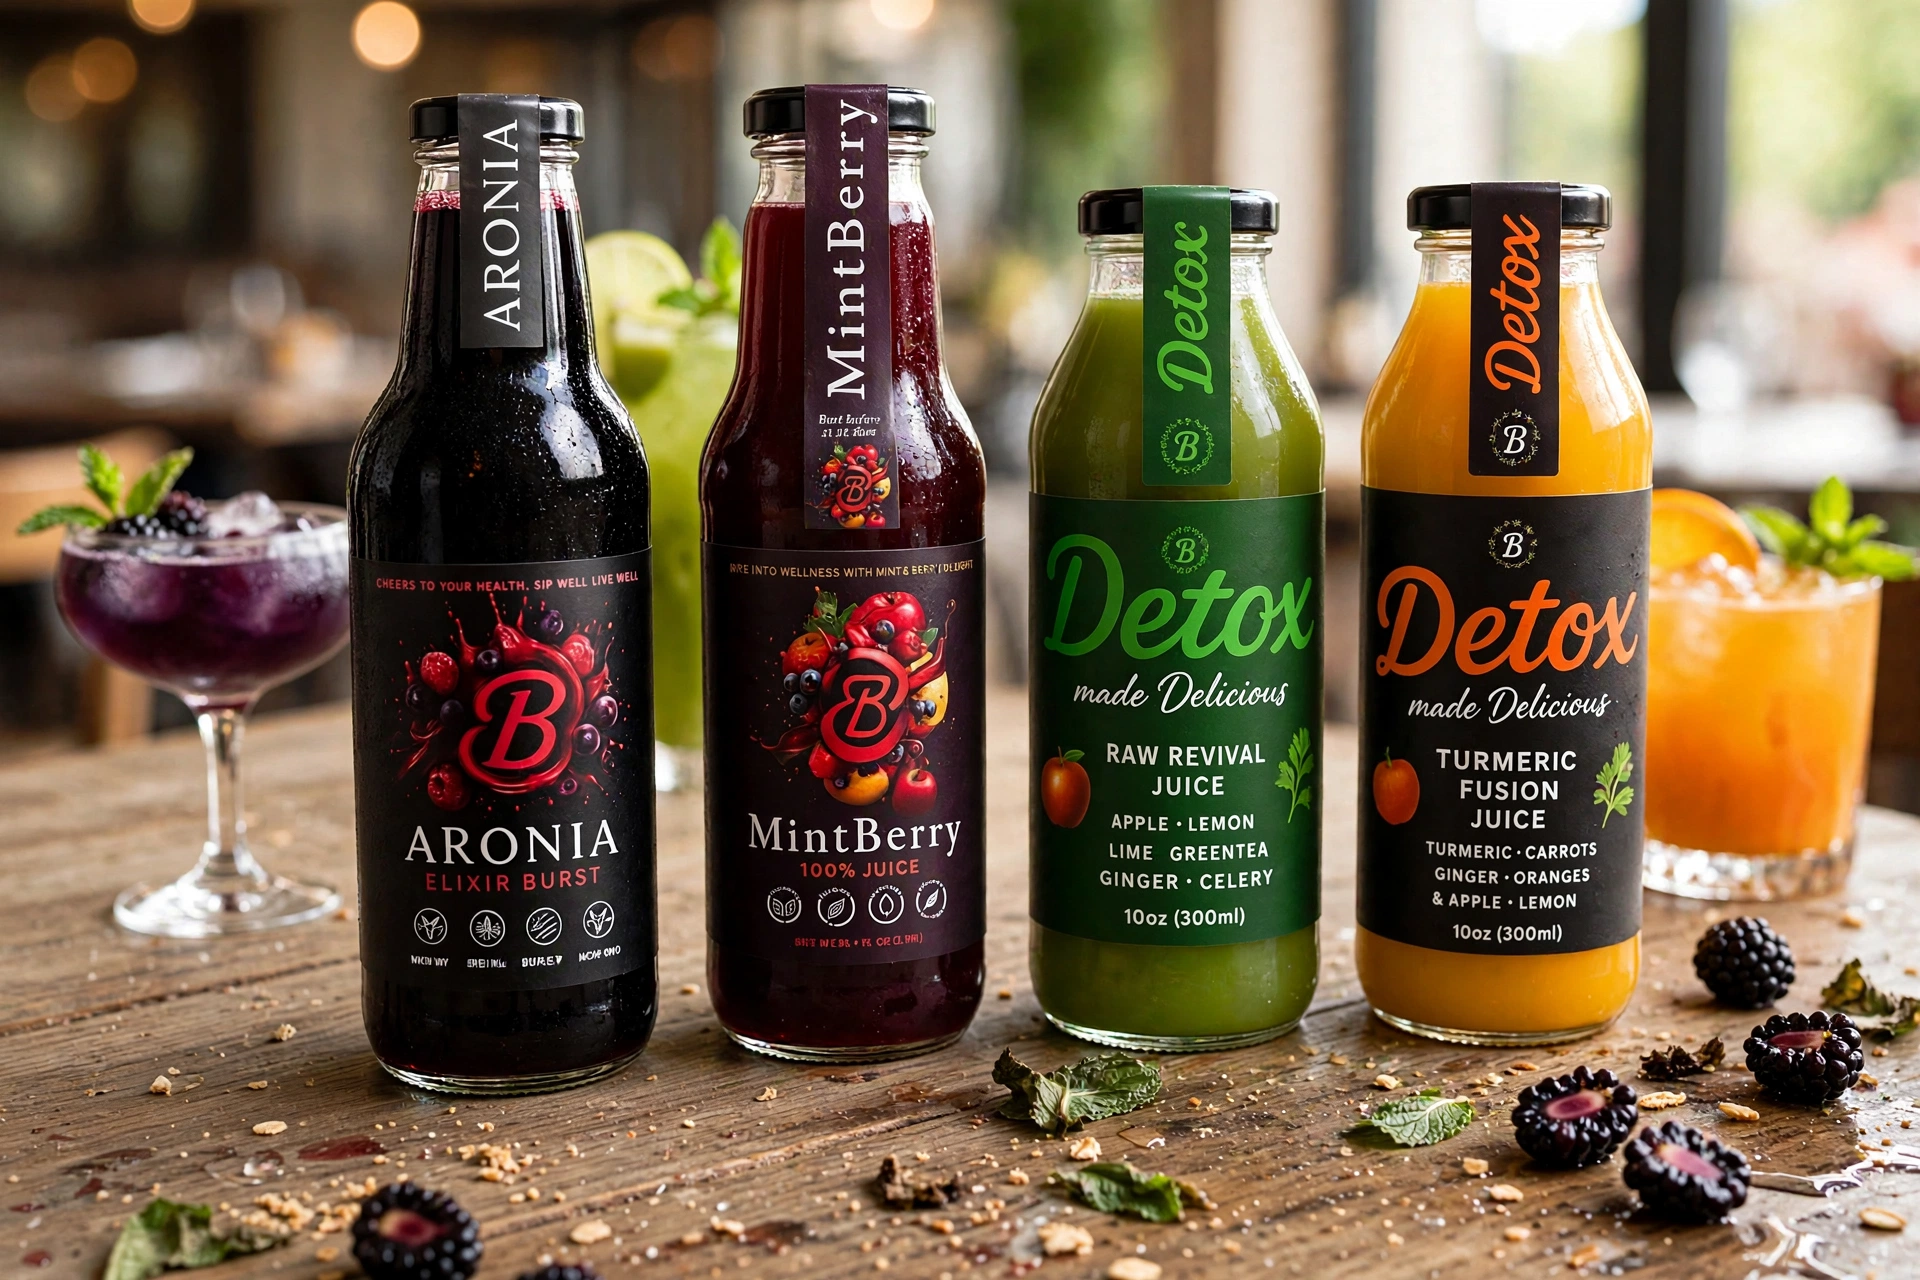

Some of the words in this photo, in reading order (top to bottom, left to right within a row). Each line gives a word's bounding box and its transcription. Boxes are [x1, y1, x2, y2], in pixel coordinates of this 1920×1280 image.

[483, 119, 520, 331] ARONIA
[827, 99, 878, 400] MintBerry
[1157, 221, 1214, 395] Detox
[1484, 213, 1541, 394] Detox
[1174, 430, 1200, 461] B
[1503, 425, 1527, 455] B
[1175, 538, 1196, 563] B
[1502, 532, 1523, 558] B
[376, 577, 416, 591] CHEERS
[420, 580, 436, 591] TO
[440, 581, 472, 592] YOUR
[476, 580, 530, 592] HEALTH.
[533, 579, 553, 590] SIP
[556, 576, 588, 589] WELL
[592, 573, 614, 586] LIVE
[616, 570, 639, 584] WELL
[751, 564, 777, 576] INTO
[780, 566, 840, 578] WELLNESS
[843, 566, 873, 578] WITH
[1044, 533, 1314, 660] Detox
[1376, 565, 1639, 677] Detox
[1073, 673, 1150, 708] made
[1157, 671, 1289, 714] Delicious
[1407, 687, 1482, 720] made
[1487, 683, 1612, 724] Delicious
[474, 669, 567, 770] B
[1106, 742, 1159, 765] RAW
[1168, 743, 1266, 766] REVIVAL
[1435, 748, 1577, 772] TURMERIC
[1151, 775, 1225, 796] JUICE
[1460, 779, 1559, 801] FUSION
[1111, 813, 1169, 832] APPLE
[1188, 813, 1255, 832] LEMON
[1470, 809, 1546, 829] JUICE
[404, 819, 619, 865] ARONIA
[748, 812, 961, 857] MintBerry
[1109, 842, 1153, 861] LIME
[1169, 841, 1270, 862] GREENTEA
[1426, 840, 1512, 860] TURMERIC
[1525, 841, 1598, 860] CARROTS
[425, 872, 511, 892] ELIXIR
[523, 866, 601, 891] BURST
[800, 862, 856, 878] 100%
[862, 858, 920, 878] JUICE
[1100, 870, 1179, 890] GINGER
[1200, 868, 1275, 890] CELERY
[1435, 866, 1499, 884] GINGER
[1513, 868, 1591, 885] ORANGES
[1432, 890, 1444, 907] &
[1449, 892, 1502, 910] APPLE
[1519, 893, 1577, 910] LEMON
[1123, 908, 1168, 926] 10oz
[1173, 907, 1246, 929] (300ml)
[1452, 924, 1492, 941] 10oz
[1497, 923, 1563, 943] (300ml)
